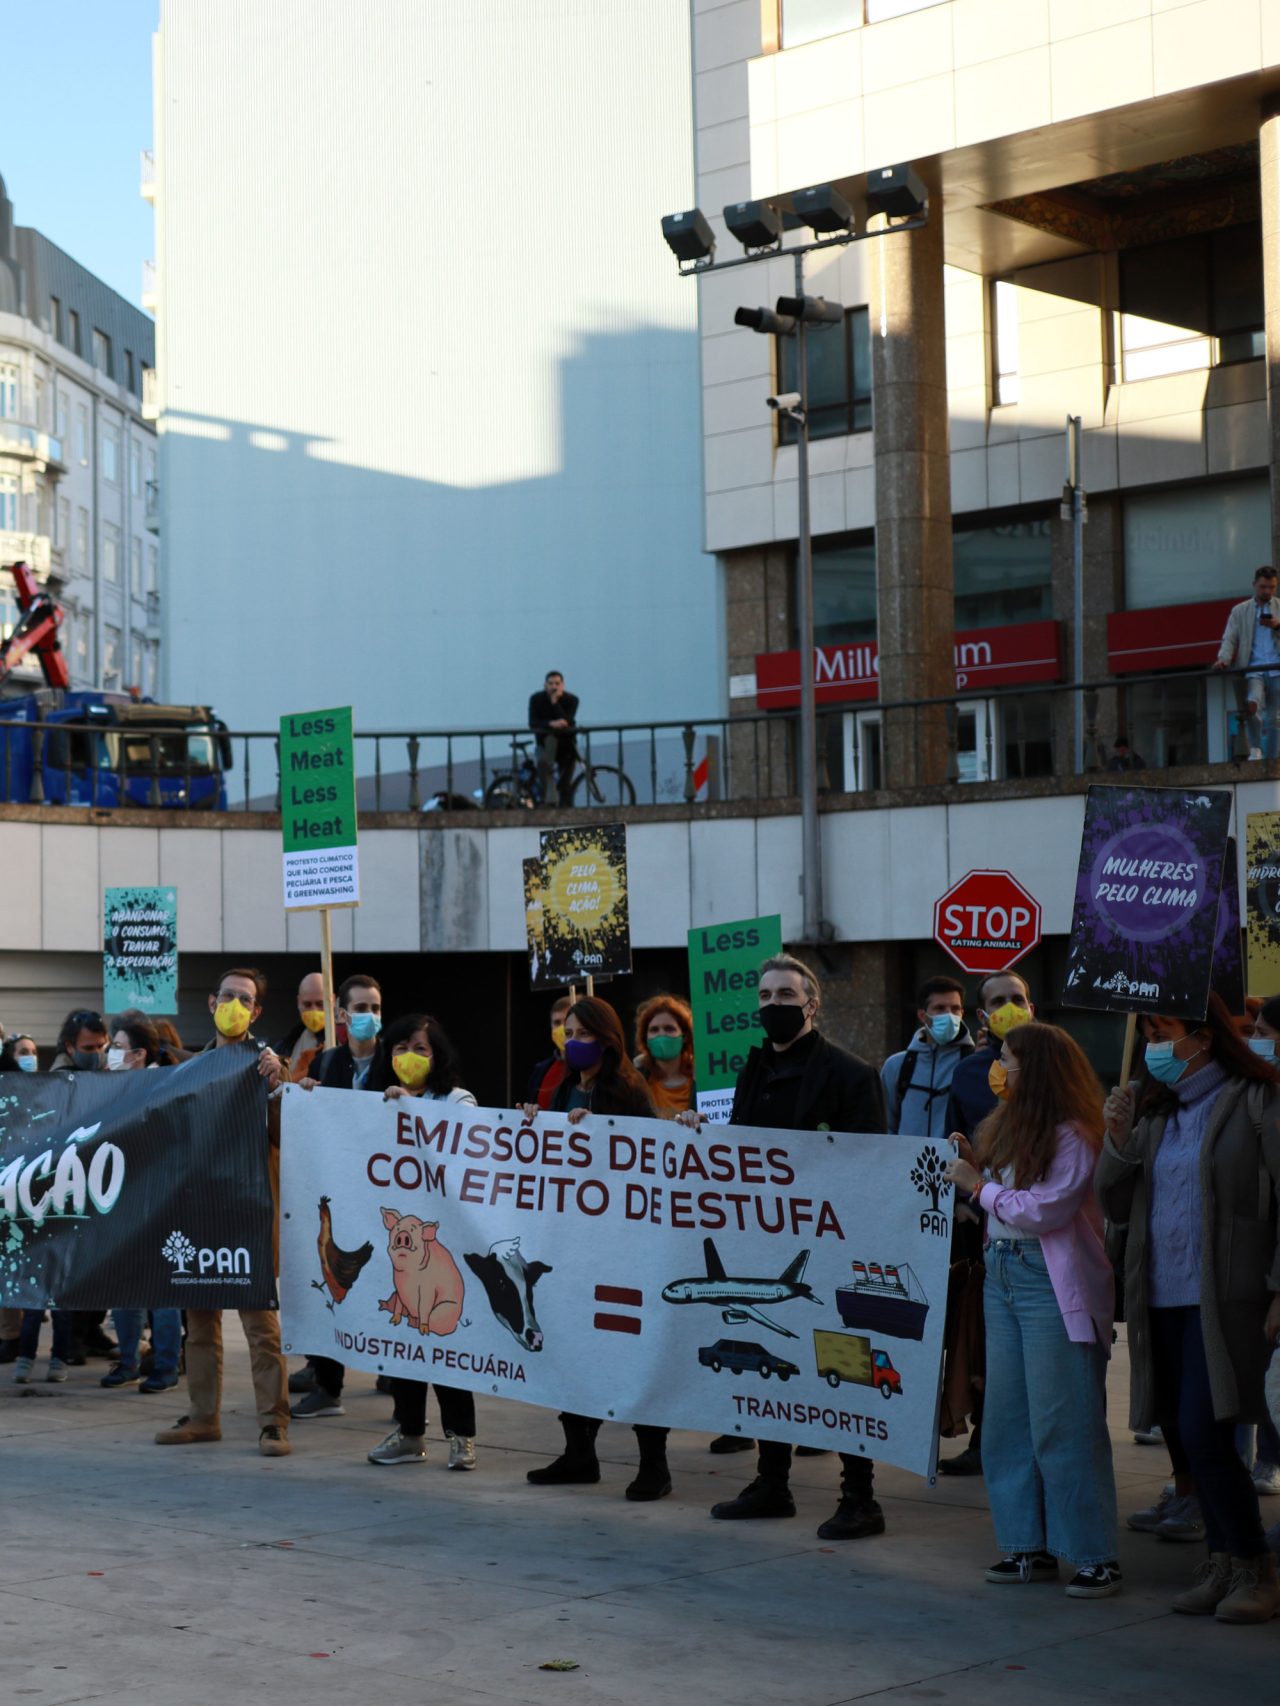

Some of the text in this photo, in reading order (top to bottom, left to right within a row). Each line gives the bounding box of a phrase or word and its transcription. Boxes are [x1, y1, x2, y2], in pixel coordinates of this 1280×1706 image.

[289, 718, 335, 738] Less
[291, 748, 344, 771] Meat
[291, 785, 337, 806] Less
[293, 816, 342, 840] Heat
[286, 857, 318, 866] PROTESTO
[287, 864, 353, 877] QUE NÃO CONDENE
[571, 864, 596, 877] PELO
[1103, 856, 1198, 882] MULHERES
[286, 878, 321, 888] PECUÁRIA
[329, 875, 353, 884] PESCA
[294, 886, 354, 898] GREENWASHING
[569, 896, 601, 913] AÇÃO!
[1095, 883, 1198, 907] PELO CLIMA
[111, 909, 170, 922] ABANDONAR
[943, 904, 1031, 939] STOP
[112, 926, 119, 937] O
[702, 928, 760, 954] Less
[123, 941, 160, 953] TRAVAR
[951, 938, 1021, 949] EATING ANIMALS
[107, 953, 174, 968] A EXPLORAÇÃO
[584, 954, 603, 964] PAN
[704, 967, 760, 995] Mea
[706, 1011, 762, 1036] Less
[397, 1111, 795, 1186] EMISSÕES DE GASES
[367, 1153, 846, 1240] COM EFEITO DE ESTUFA
[920, 1213, 948, 1238] PAN
[198, 1247, 251, 1274] PAN
[334, 1327, 526, 1383] INDÚSTRIA PECUÁRIA
[732, 1396, 888, 1441] TRANSPORTES
